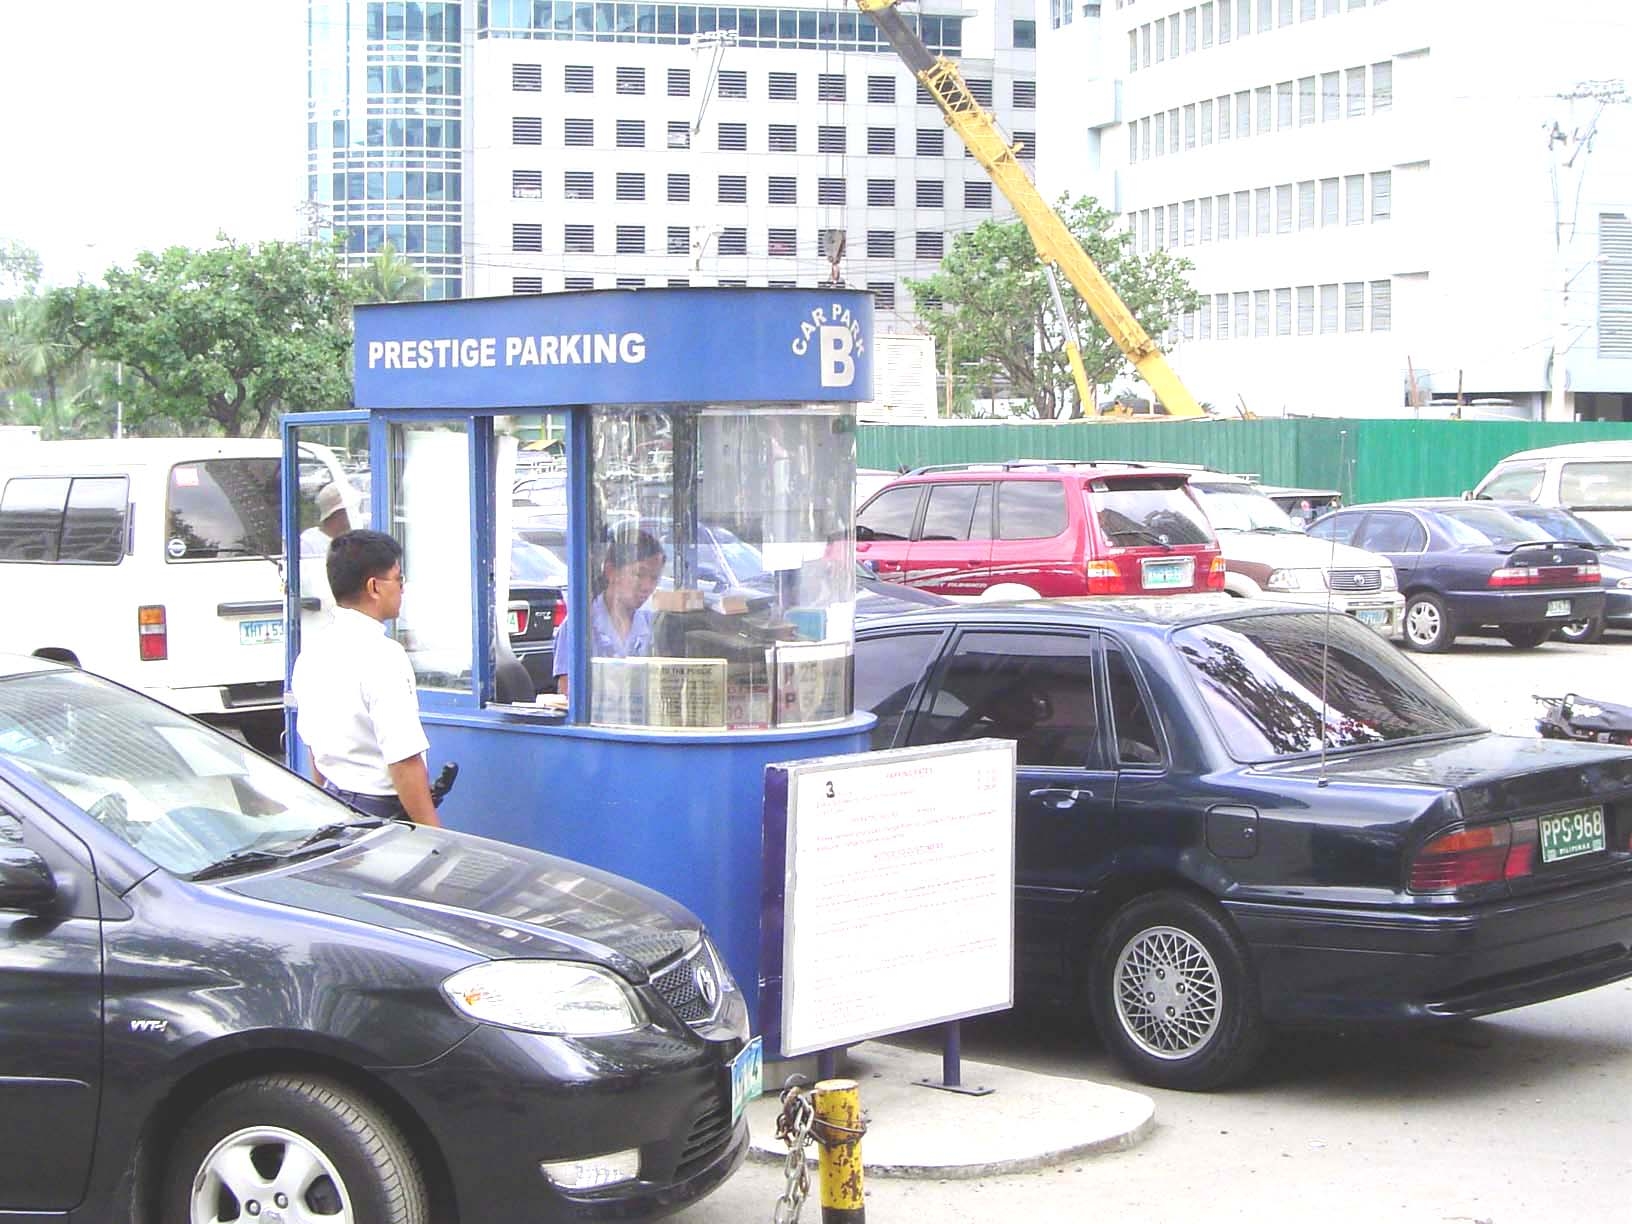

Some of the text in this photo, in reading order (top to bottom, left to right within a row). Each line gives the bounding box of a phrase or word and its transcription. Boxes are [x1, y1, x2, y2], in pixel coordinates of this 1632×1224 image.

[792, 303, 865, 358] CAR PARK
[368, 332, 647, 369] PRESTIGE PARKING
[820, 325, 856, 387] B
[243, 622, 263, 638] XHT
[825, 780, 836, 799] 3
